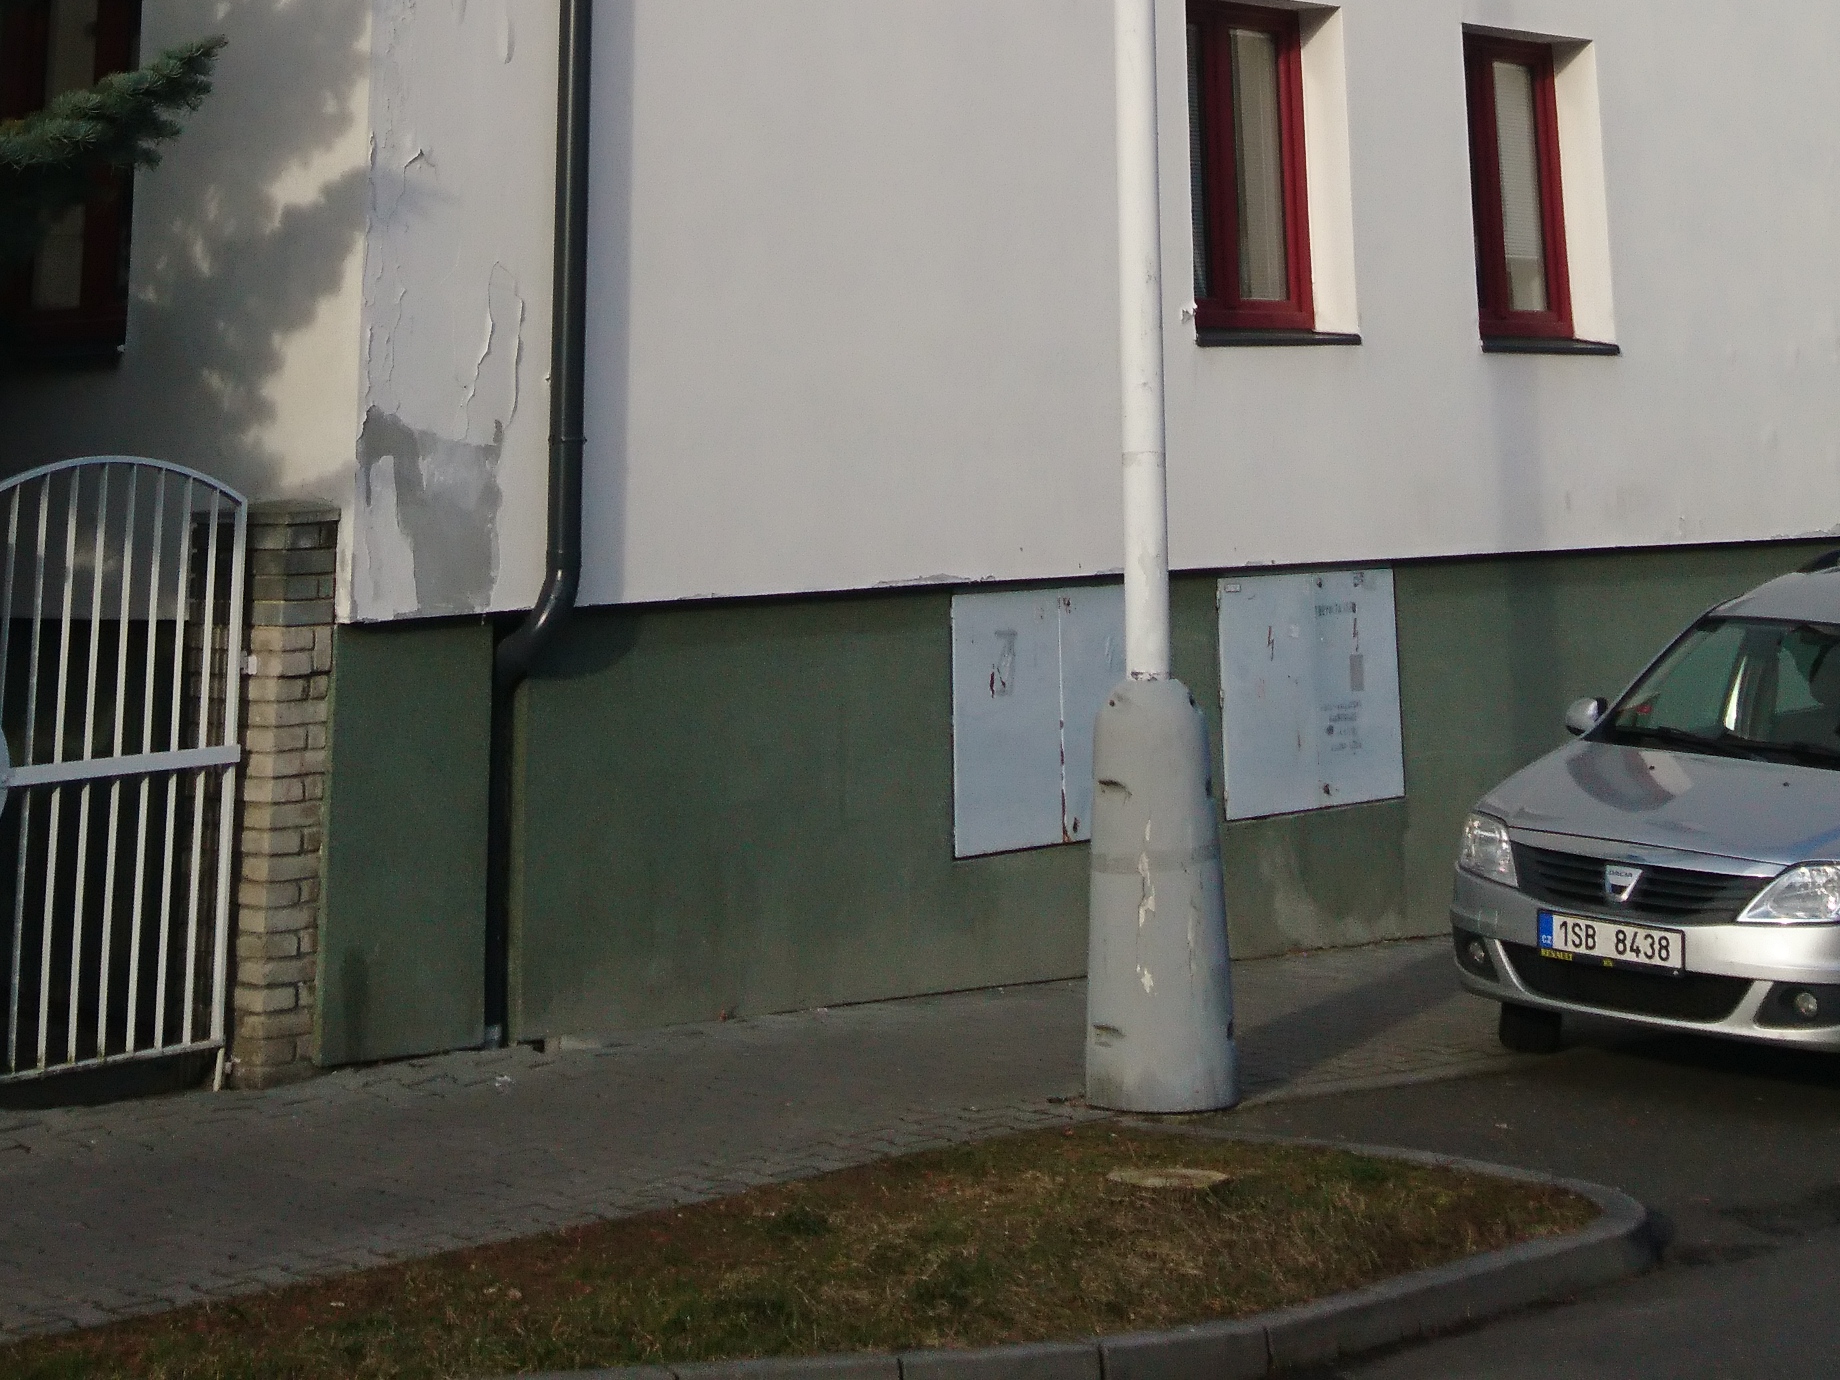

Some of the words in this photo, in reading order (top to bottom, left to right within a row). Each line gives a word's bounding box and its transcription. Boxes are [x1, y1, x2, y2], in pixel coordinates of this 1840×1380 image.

[1541, 934, 1553, 945] CZ
[1559, 920, 1597, 951] 1SB
[1614, 929, 1671, 962] 8438
